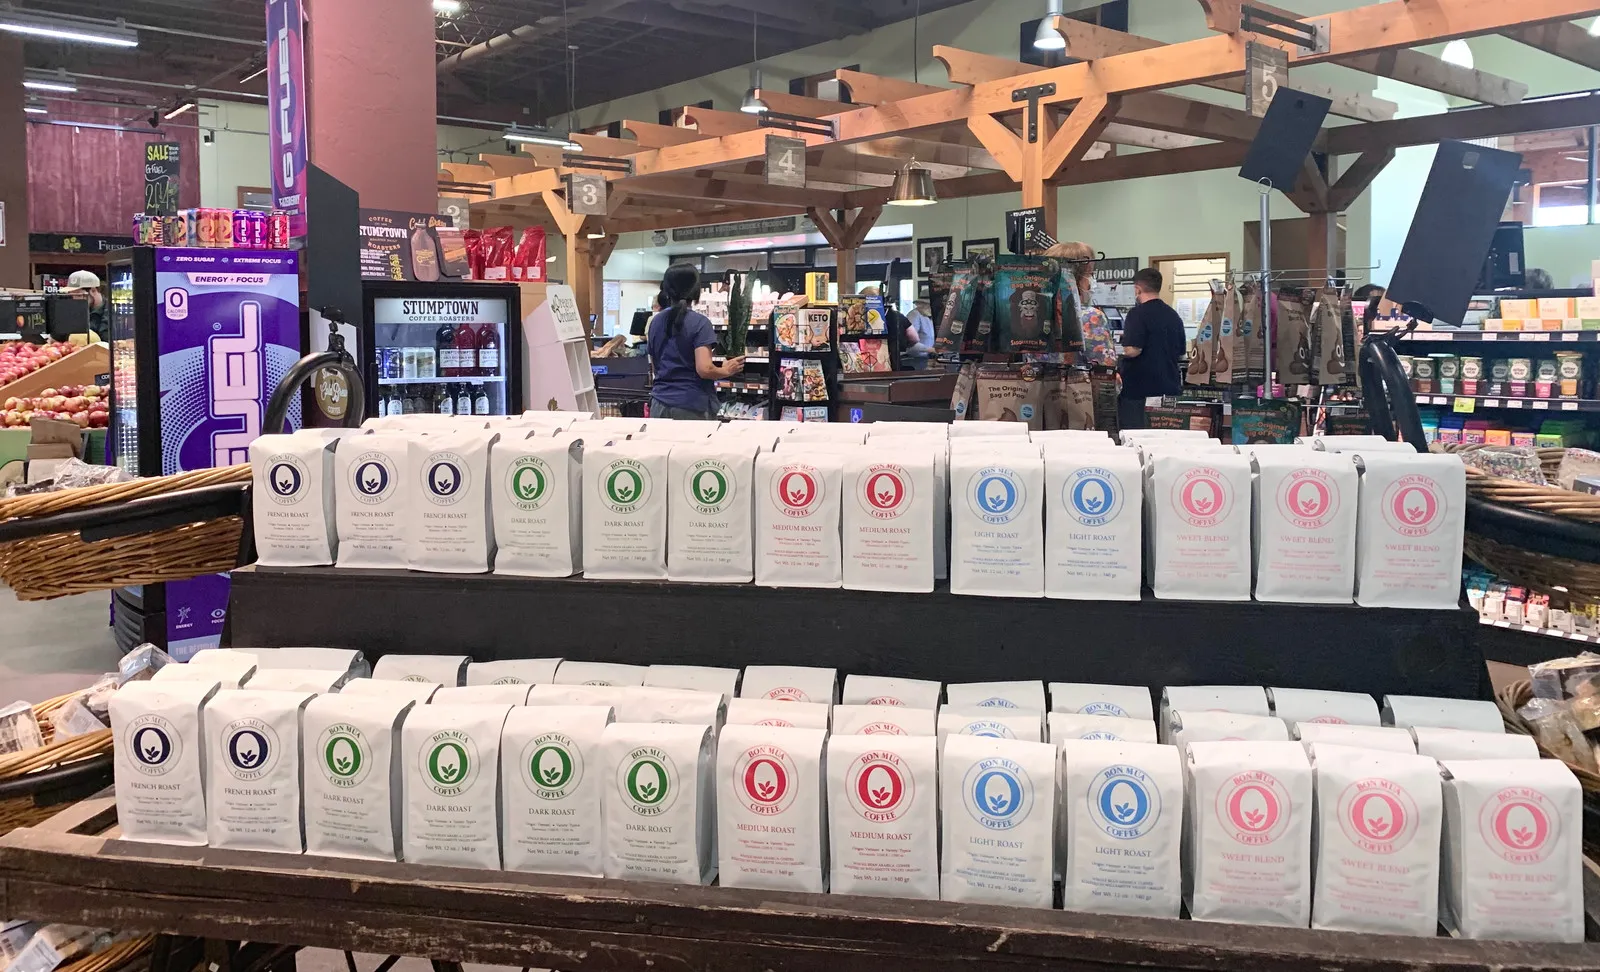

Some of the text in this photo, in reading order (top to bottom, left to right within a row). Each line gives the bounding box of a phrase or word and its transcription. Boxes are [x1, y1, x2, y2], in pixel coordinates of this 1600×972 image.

[1262, 63, 1277, 101] 5
[148, 145, 169, 160] SALE
[779, 149, 796, 176] 4
[582, 183, 597, 205] 3
[360, 226, 407, 238] STUMPTOWN
[403, 301, 479, 315] STUMPTOWN
[808, 314, 828, 322] KETO
[805, 408, 825, 417] KETO
[328, 726, 344, 735] BON
[433, 731, 469, 743] BON MUA
[535, 734, 571, 746] BON MUA
[631, 749, 666, 762] BON MUA
[748, 747, 766, 758] BON
[861, 752, 899, 765] BON MUA
[979, 759, 999, 770] BON
[1104, 767, 1145, 781] BON MUA
[1233, 773, 1253, 786] BON
[225, 788, 251, 796] FRENCH
[434, 786, 462, 795] COFFEE
[537, 789, 565, 797] COFFEE
[324, 793, 341, 801] DARK
[633, 805, 662, 814] COFFEE
[750, 803, 780, 814] COFFEE
[864, 811, 896, 821] COFFEE
[980, 817, 1014, 828] COFFEE
[737, 823, 796, 834] MEDIUM ROAST
[1106, 825, 1141, 837] COFFEE
[851, 831, 884, 839] MEDIUM
[970, 837, 1024, 849] LIGHT ROAST
[1095, 846, 1151, 857] LIGHT ROAST
[1222, 852, 1284, 863] SWEET BLEND
